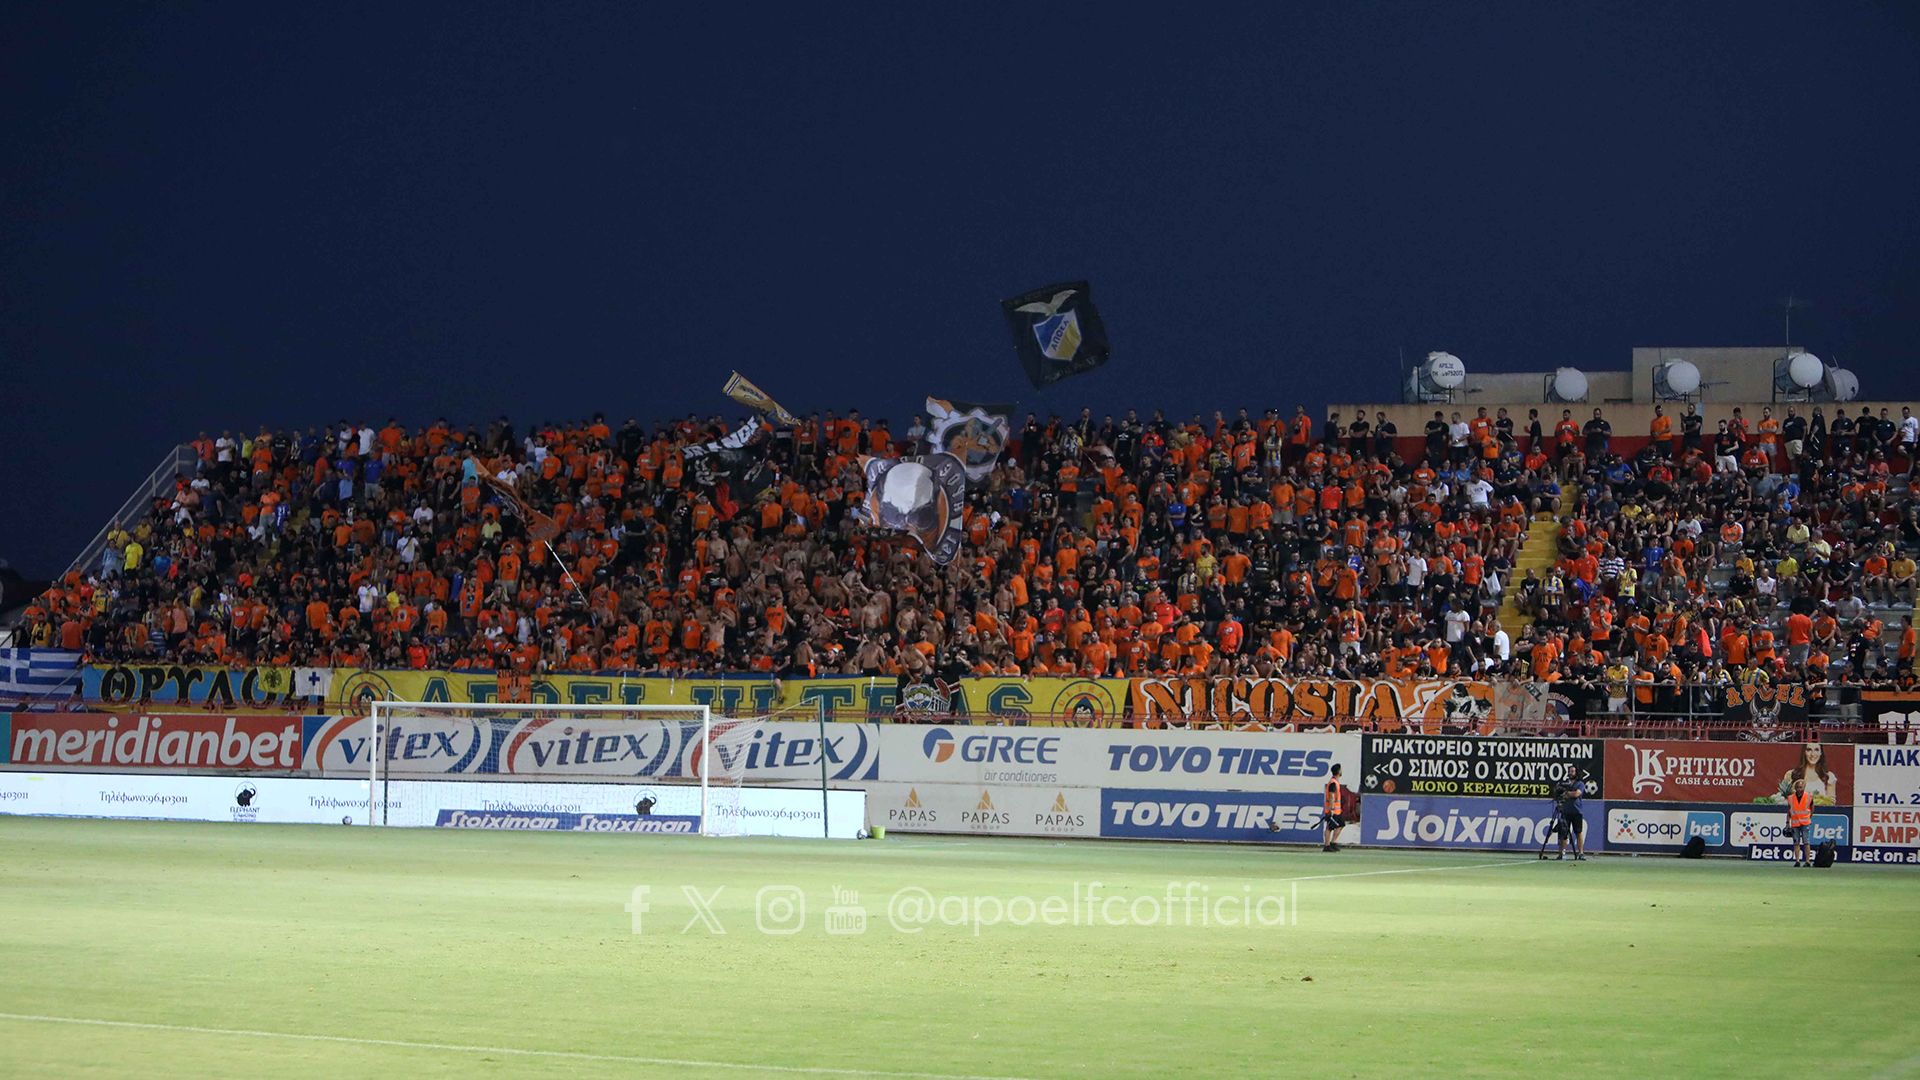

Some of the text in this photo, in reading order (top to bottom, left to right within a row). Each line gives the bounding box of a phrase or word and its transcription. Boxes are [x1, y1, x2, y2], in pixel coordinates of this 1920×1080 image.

[691, 683, 1033, 726] ULTRS
[12, 716, 299, 767] meridianbet
[338, 724, 460, 764] vitex
[529, 726, 648, 767] vitex
[715, 729, 844, 771] vitex
[961, 735, 1060, 765] GREE
[1372, 738, 1593, 759] ΠΡΑΚΤΟΡΕΙΟ ΣΤΟΙΧΗΜΑΤΩΝ
[1108, 745, 1333, 778] TOYO TIRES
[1408, 759, 1469, 778] ΣΙΜΟΣ
[984, 769, 1057, 783] air conditioners
[1675, 777, 1745, 787] CASH & CARRY
[1411, 780, 1550, 796] ΜΟΝΟ ΚΕΡΔΙΖΕΤΕ
[444, 811, 559, 830] Stoiximan
[573, 815, 692, 833] Stoiximan
[889, 809, 937, 822] PAPAS
[961, 811, 1009, 824] PAPAS
[1035, 813, 1085, 826] PAPAS
[1112, 801, 1325, 831] TOYO TIRES
[1376, 800, 1588, 845] Stoixima
[1637, 820, 1721, 840] opap bet
[1813, 823, 1844, 840] bet
[1860, 826, 1920, 844] PAMP
[1751, 845, 1780, 860] bet
[1851, 847, 1880, 862] bet
[1883, 851, 1904, 862] on
